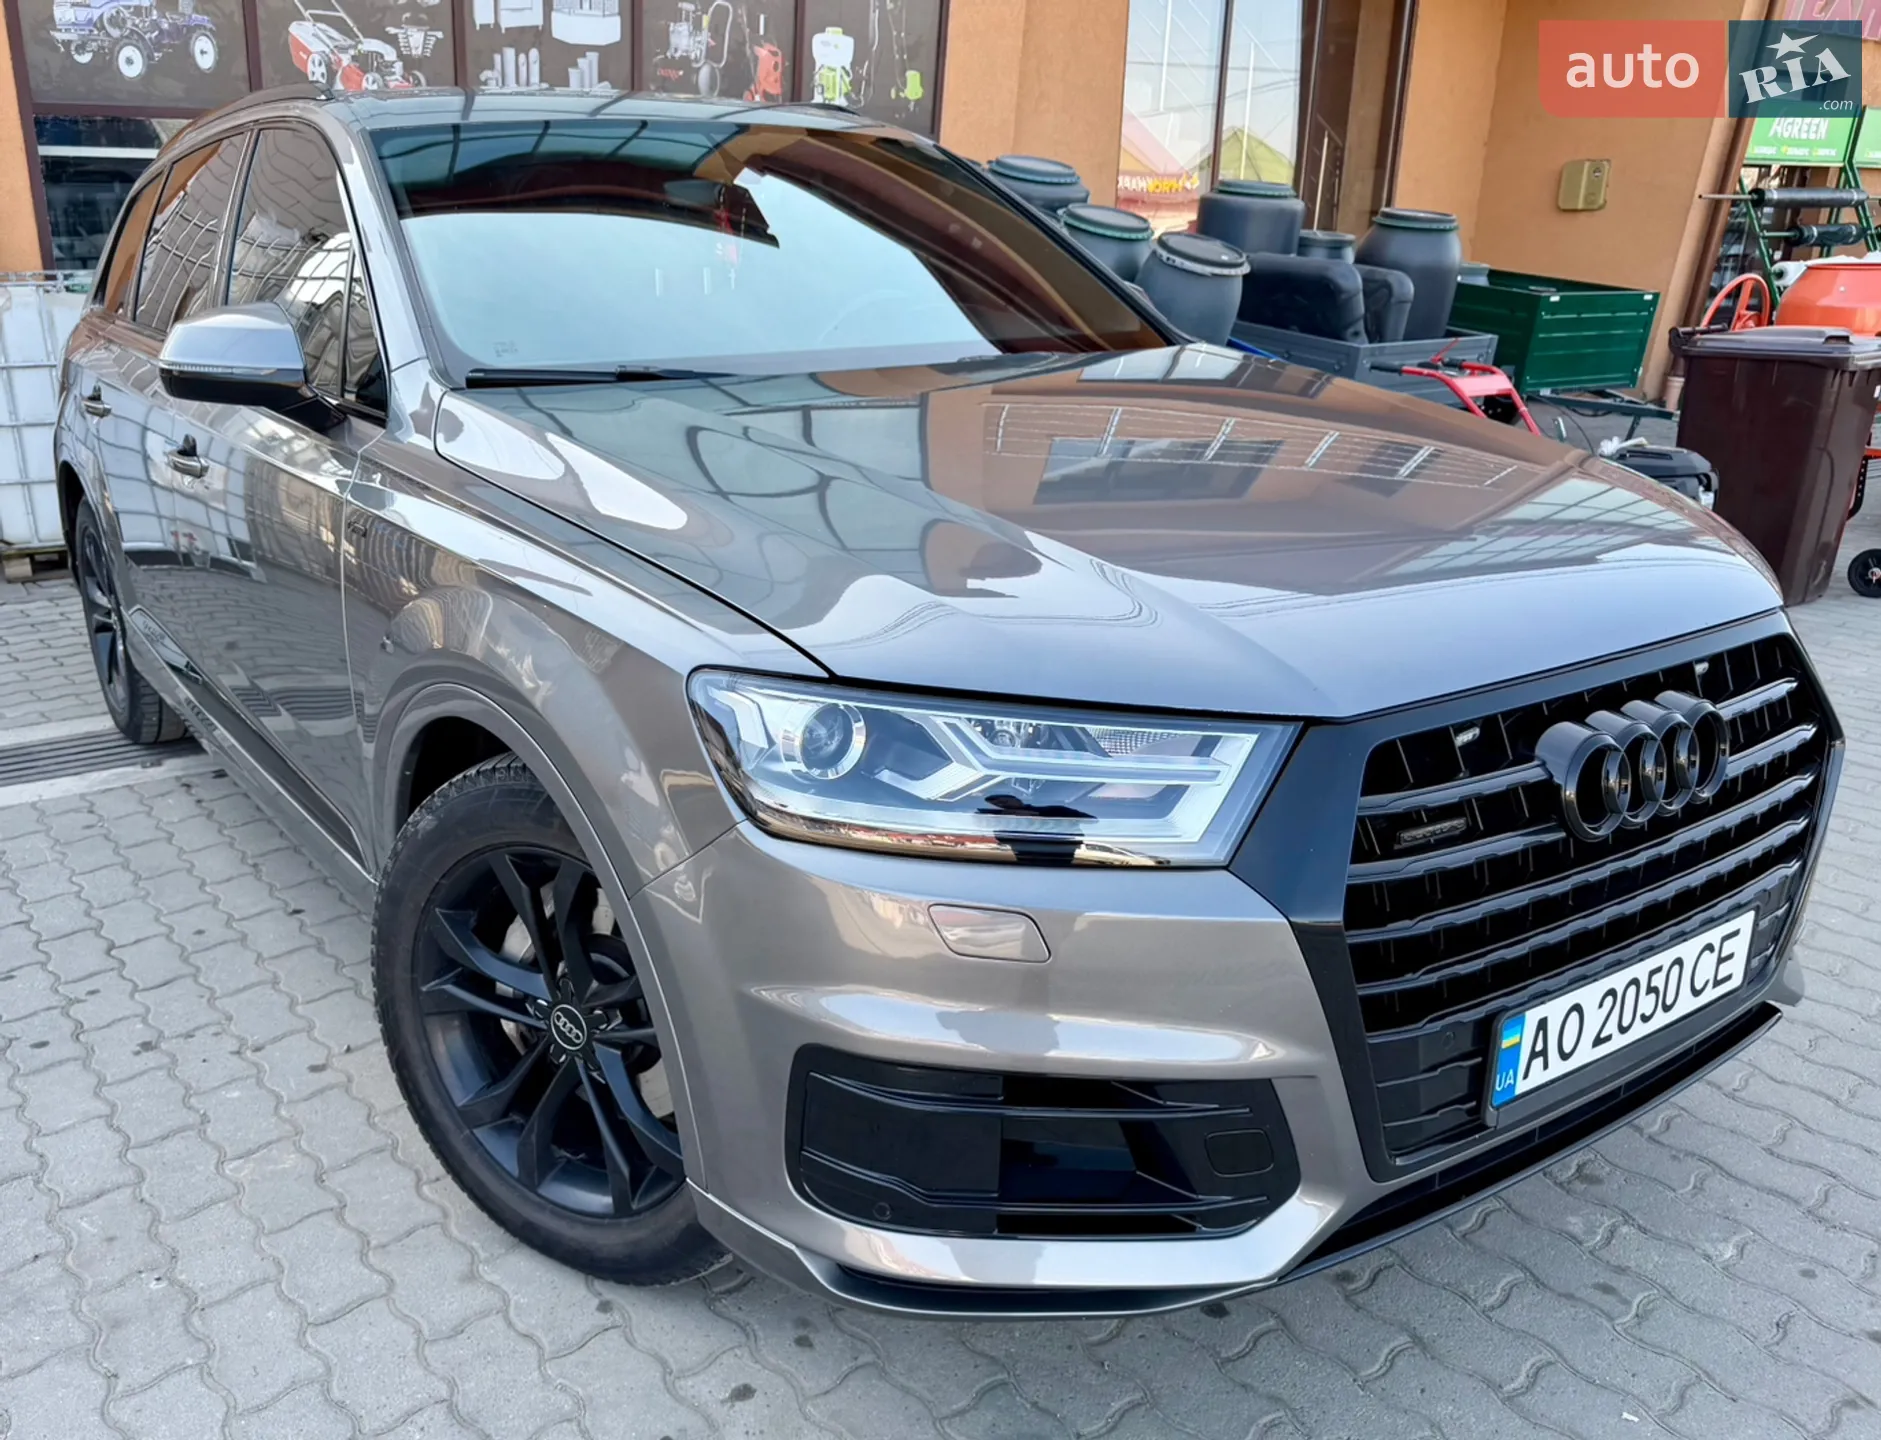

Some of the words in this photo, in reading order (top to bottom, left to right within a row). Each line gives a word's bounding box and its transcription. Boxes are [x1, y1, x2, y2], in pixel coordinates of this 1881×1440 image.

[1769, 116, 1830, 141] AGREEN
[1522, 1002, 1585, 1081] AO
[1591, 956, 1684, 1049] 2050
[1690, 928, 1741, 998] CE
[1495, 1069, 1515, 1092] UA
